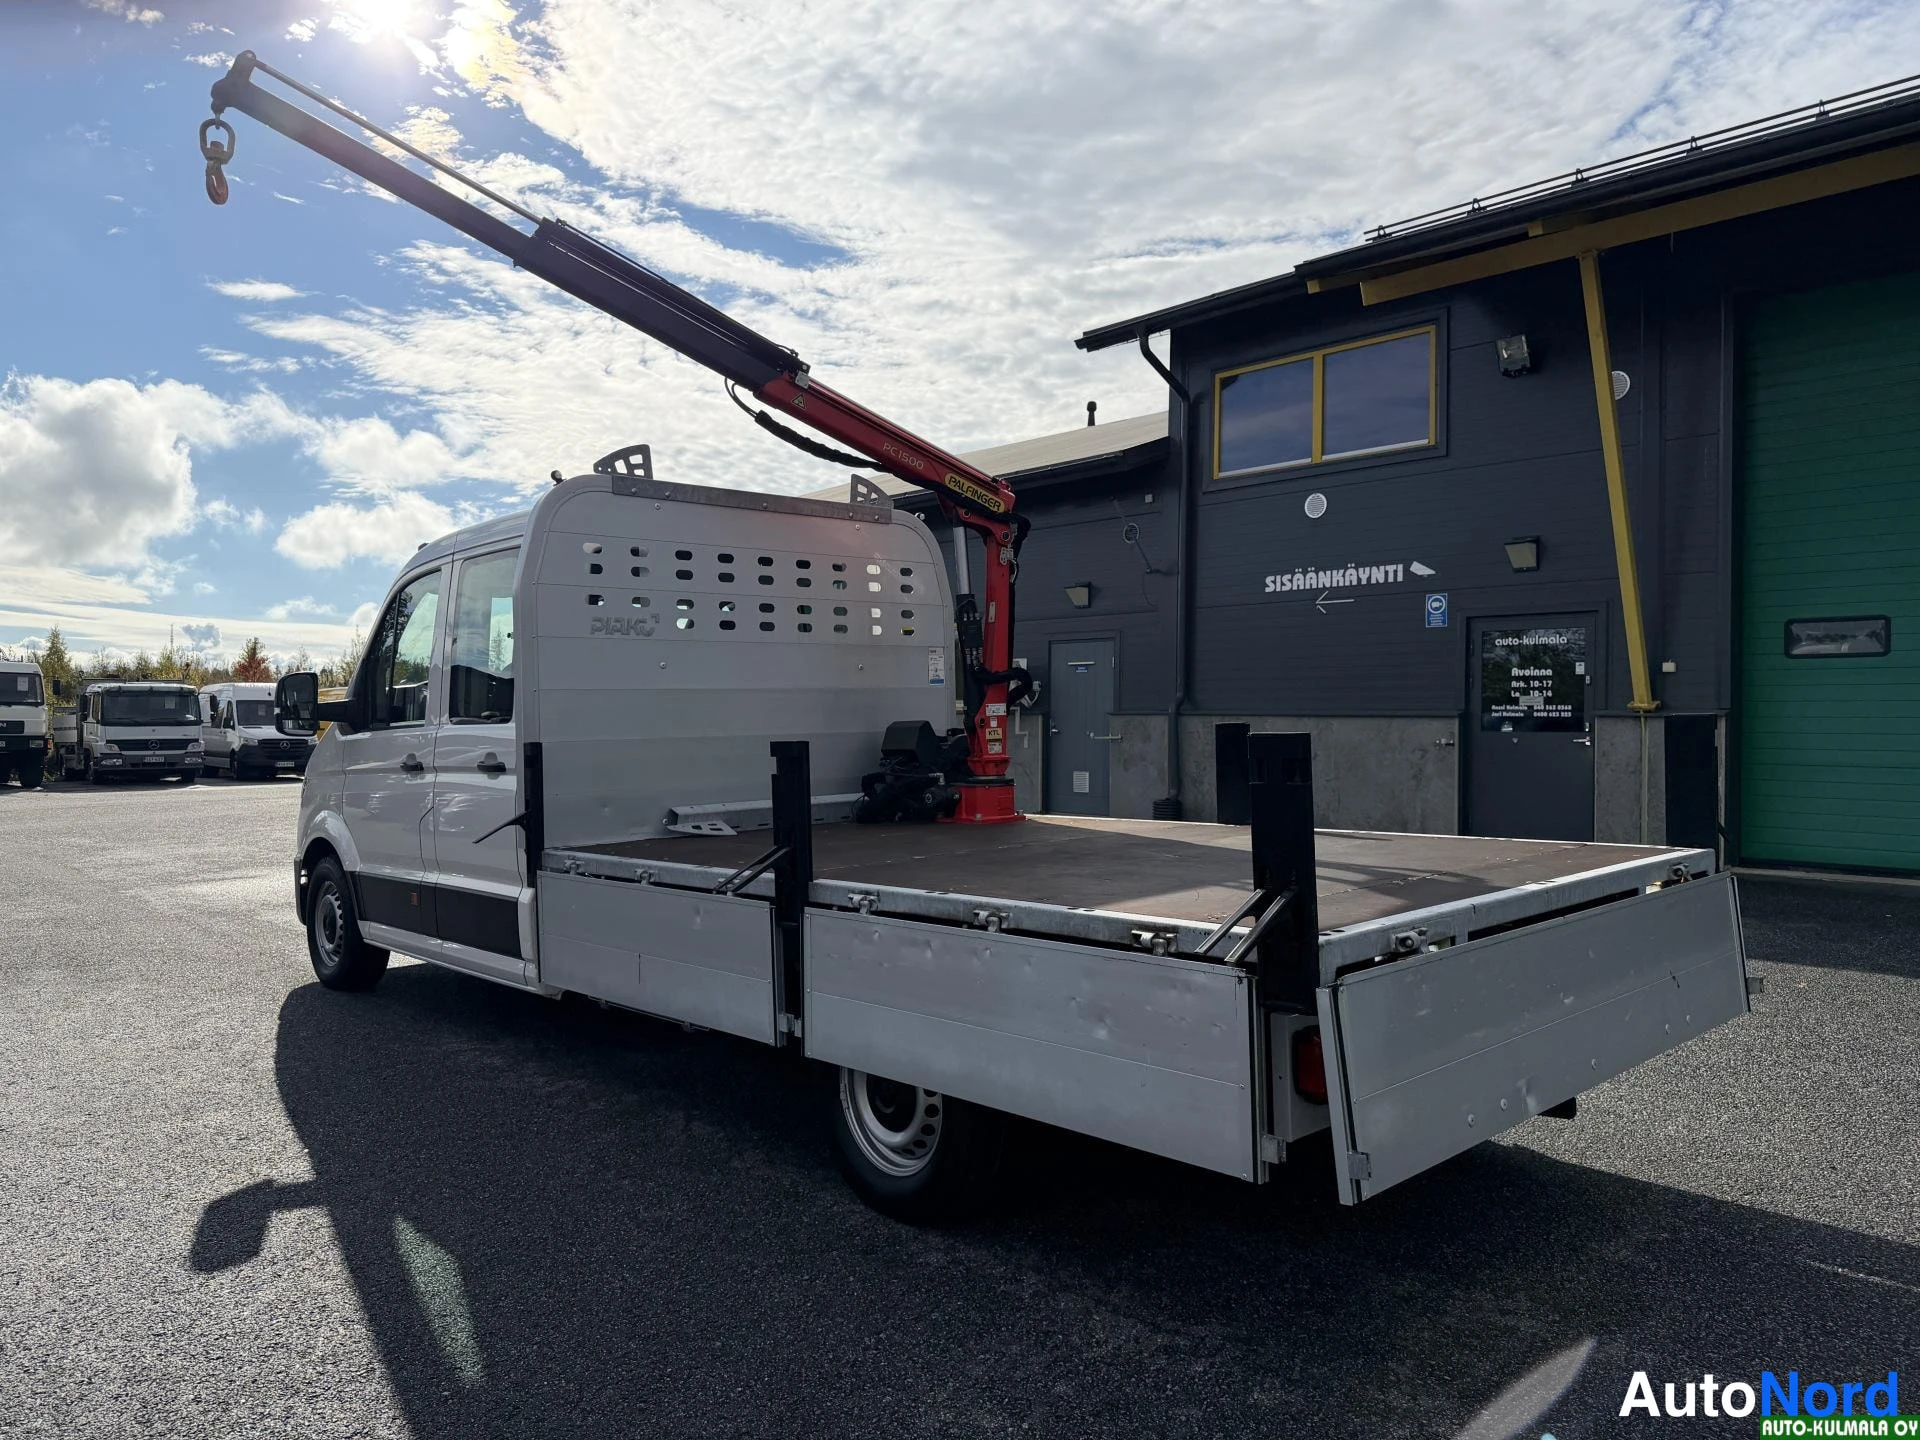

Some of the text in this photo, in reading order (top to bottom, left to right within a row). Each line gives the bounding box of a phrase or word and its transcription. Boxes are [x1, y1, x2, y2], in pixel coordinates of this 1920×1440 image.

[898, 450, 924, 470] 1500
[948, 475, 1001, 511] PALFINGER
[1264, 563, 1404, 592] SISÄÄNKÄYNTI
[1495, 634, 1568, 646] auto-kulmala
[1511, 666, 1552, 676] Avoinna
[1530, 680, 1552, 688] 10-17
[1530, 690, 1552, 698] 10-14
